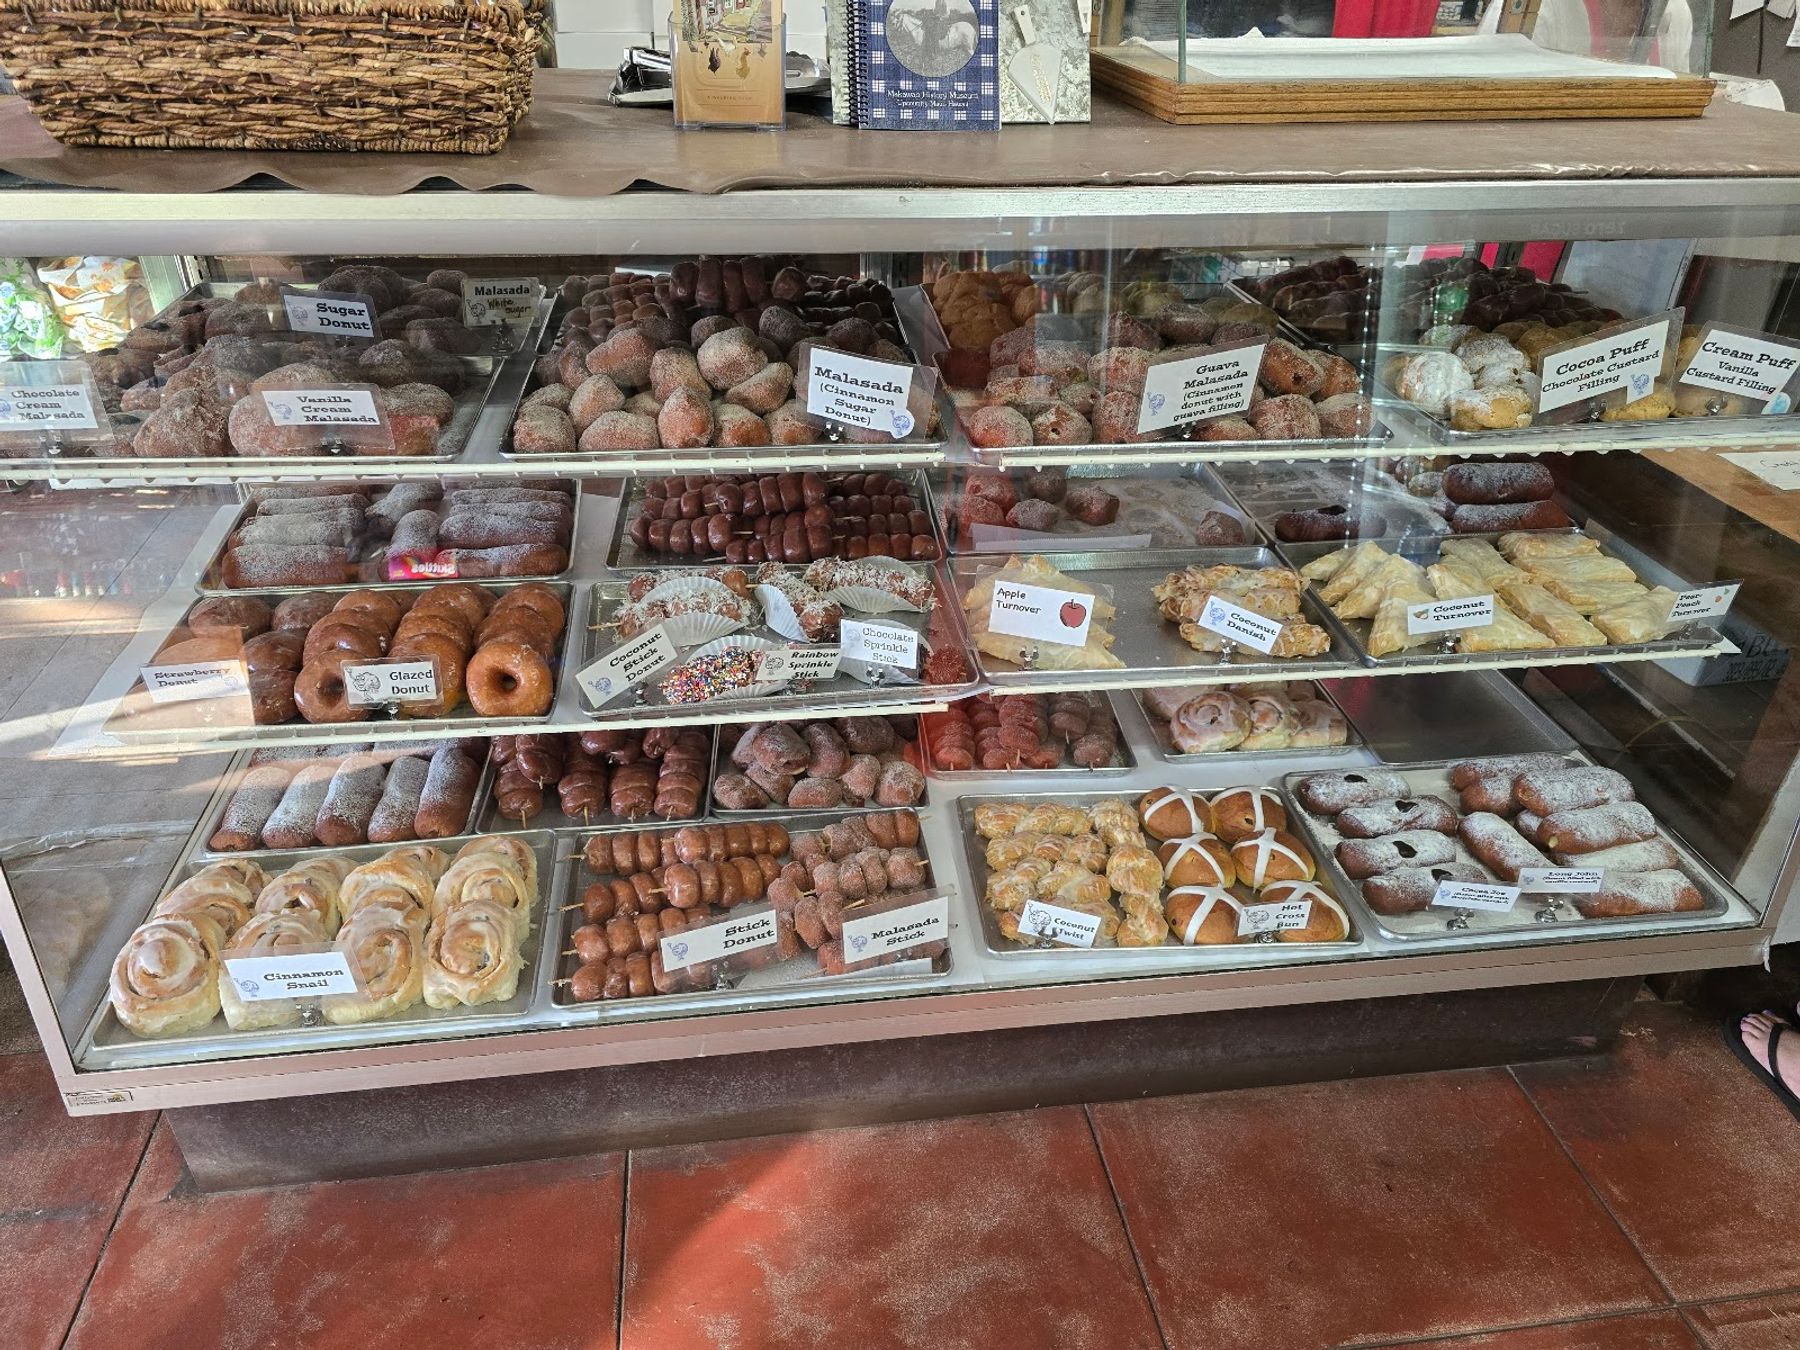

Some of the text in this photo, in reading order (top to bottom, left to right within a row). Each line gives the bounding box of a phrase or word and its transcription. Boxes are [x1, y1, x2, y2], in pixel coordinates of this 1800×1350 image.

[474, 285, 530, 295] Malasada
[316, 302, 366, 316] Sugar
[318, 316, 371, 330] Donut
[1556, 338, 1650, 375] Cocoa Puff
[1702, 341, 1797, 370] Cream Puff
[1196, 360, 1240, 375] Guava
[1542, 350, 1660, 393] Chocolate Custard
[1718, 361, 1759, 377] Vanilla
[814, 366, 904, 394] Malasada
[1183, 370, 1249, 390] Malasada
[1577, 374, 1621, 393] Filling
[1686, 367, 1776, 395] Custard Filling
[11, 389, 80, 398] Chocolate
[819, 382, 895, 407] (Cinnamon
[1183, 382, 1244, 401] (Cinnamon
[16, 401, 62, 409] Cream
[834, 398, 877, 414] Sugar
[1181, 391, 1242, 410] donut with
[303, 415, 377, 423] Malasada
[825, 406, 872, 426] Donut)
[1173, 400, 1245, 422] guava filling)
[997, 587, 1026, 600] Apple
[996, 599, 1042, 614] Turnover
[1433, 600, 1485, 613] Coconut
[1433, 609, 1492, 621] Turnover
[1226, 620, 1267, 642] Danish
[1230, 612, 1277, 636] Coconut
[862, 627, 914, 643] Chocolate
[609, 632, 662, 667] Coconut
[863, 639, 909, 654] Sprinkle
[623, 647, 658, 672] Stick
[791, 651, 839, 659] Rainbow
[872, 652, 898, 664] Stick
[625, 655, 666, 682] Donut
[788, 660, 834, 669] Sprinkle
[154, 668, 231, 679] Strawberry
[389, 669, 433, 681] Glazed
[792, 670, 819, 679] Stick
[157, 679, 198, 688] Donut
[391, 684, 430, 695] Donut
[725, 919, 771, 937] Stick
[871, 917, 940, 940] Malasada
[1054, 917, 1096, 933] Coconut
[1276, 921, 1300, 929] Bun
[723, 929, 775, 949] Donut
[886, 930, 925, 946] Stick
[1059, 928, 1085, 940] Twist
[263, 969, 344, 981] Cinnamon
[287, 979, 329, 990] Snail
